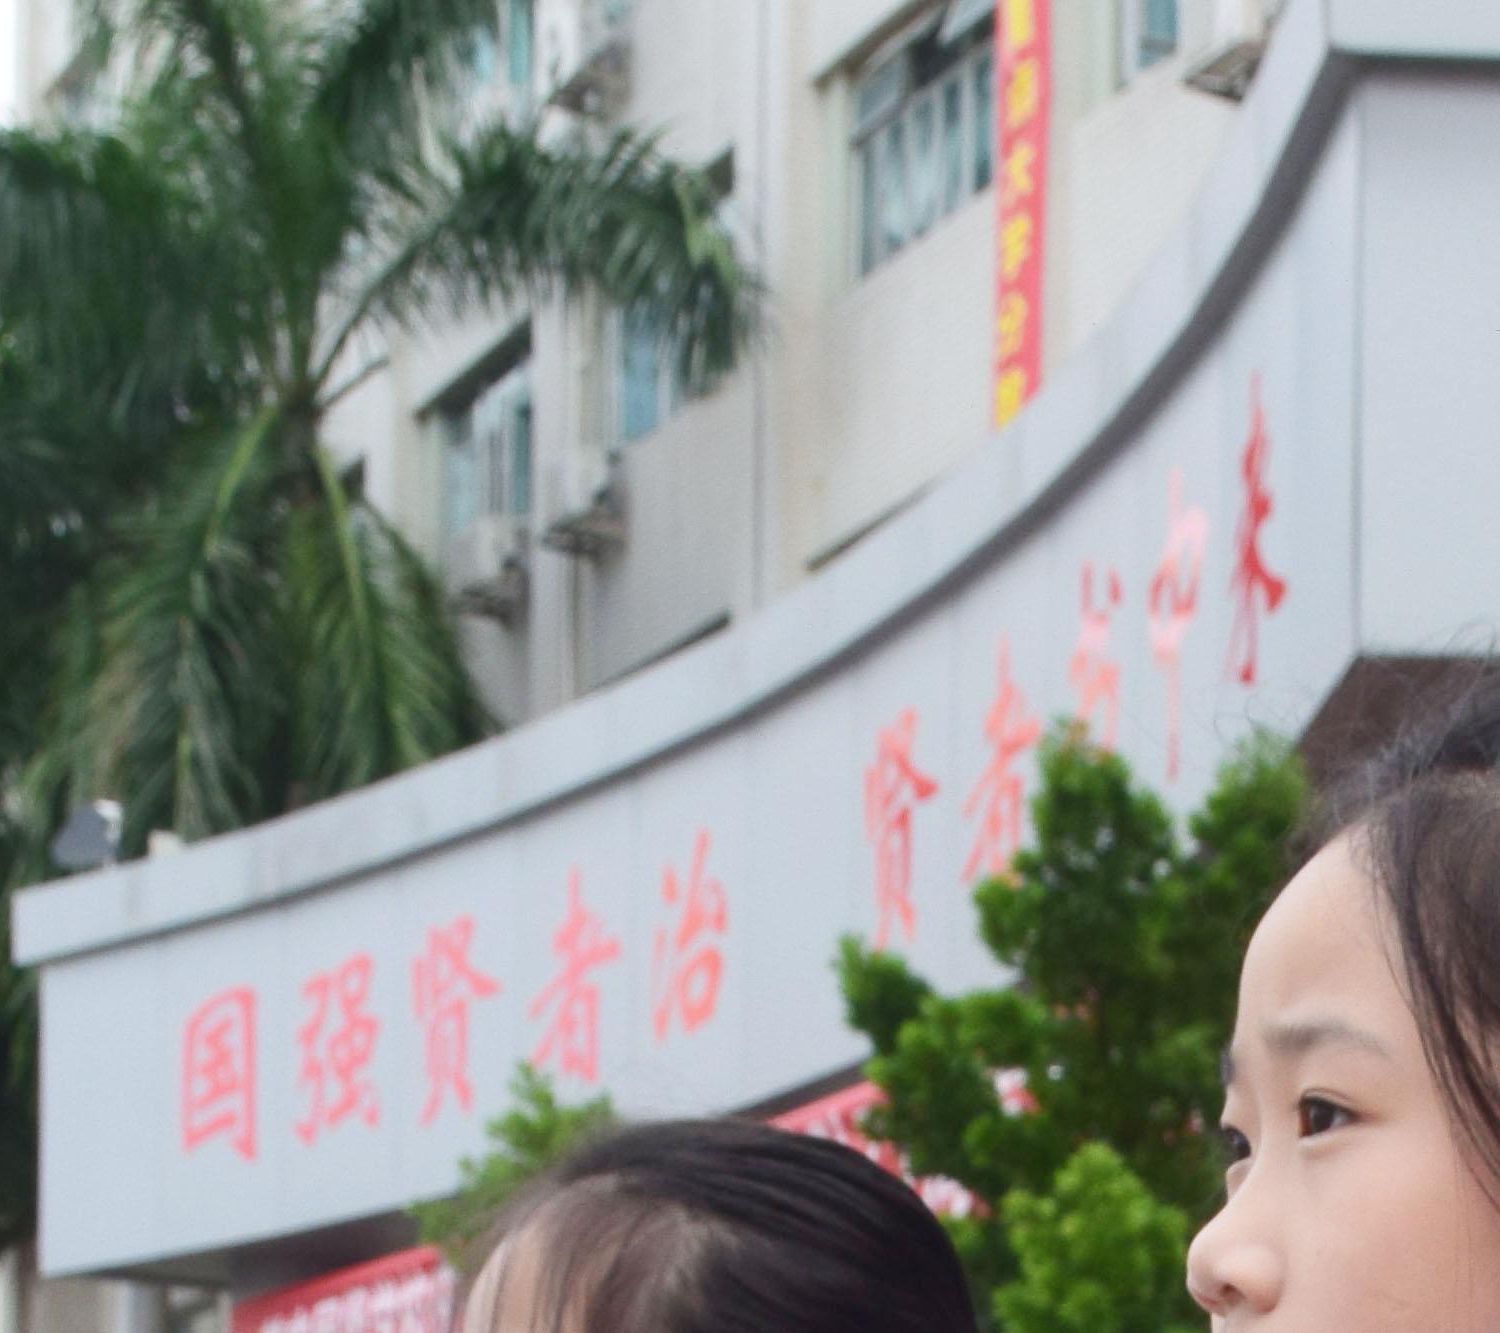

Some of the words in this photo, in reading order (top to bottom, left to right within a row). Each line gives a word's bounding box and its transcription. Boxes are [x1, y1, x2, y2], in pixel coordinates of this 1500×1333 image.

[180, 826, 731, 1163] 国强贤者治
